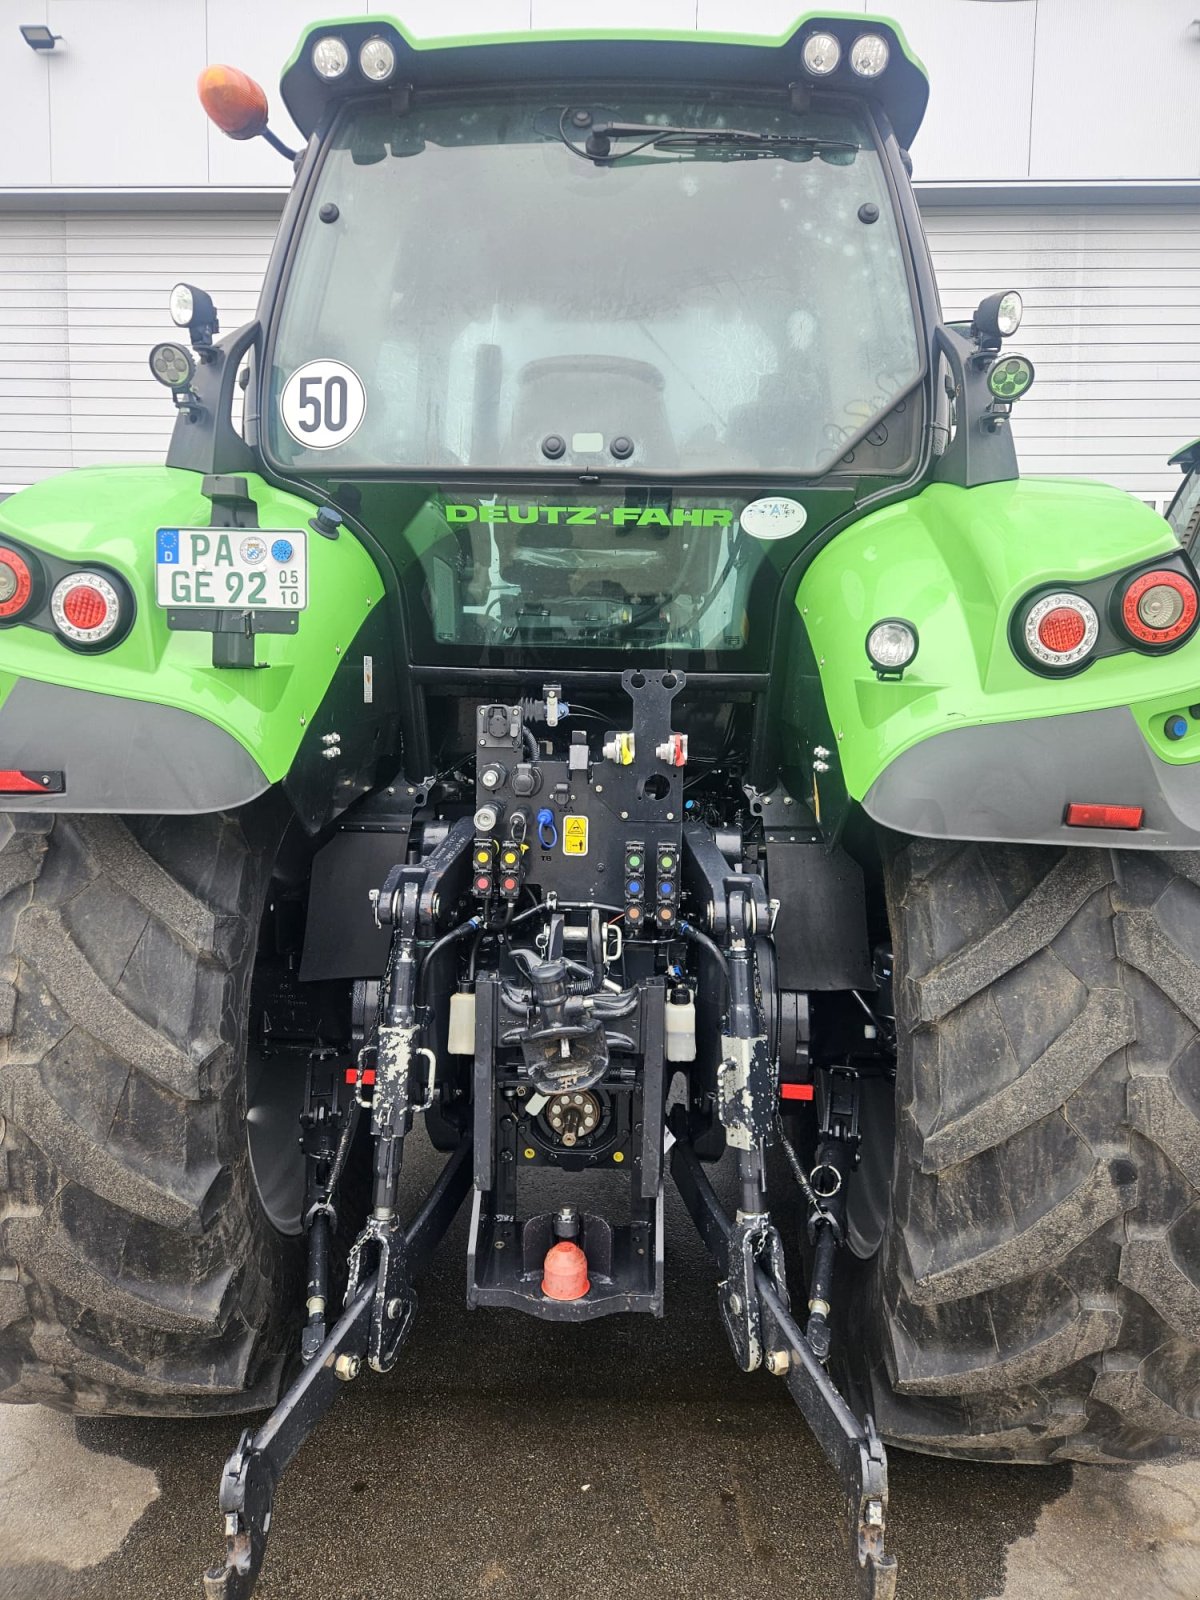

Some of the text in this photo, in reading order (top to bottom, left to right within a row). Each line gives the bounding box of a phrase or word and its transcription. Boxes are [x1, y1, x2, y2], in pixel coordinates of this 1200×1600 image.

[298, 375, 348, 433] 50
[445, 505, 733, 526] DEUTZ-FAHR
[164, 551, 173, 562] D
[190, 534, 234, 567] PA
[171, 570, 267, 604] GE 92
[279, 570, 298, 584] 05
[281, 591, 299, 605] 10
